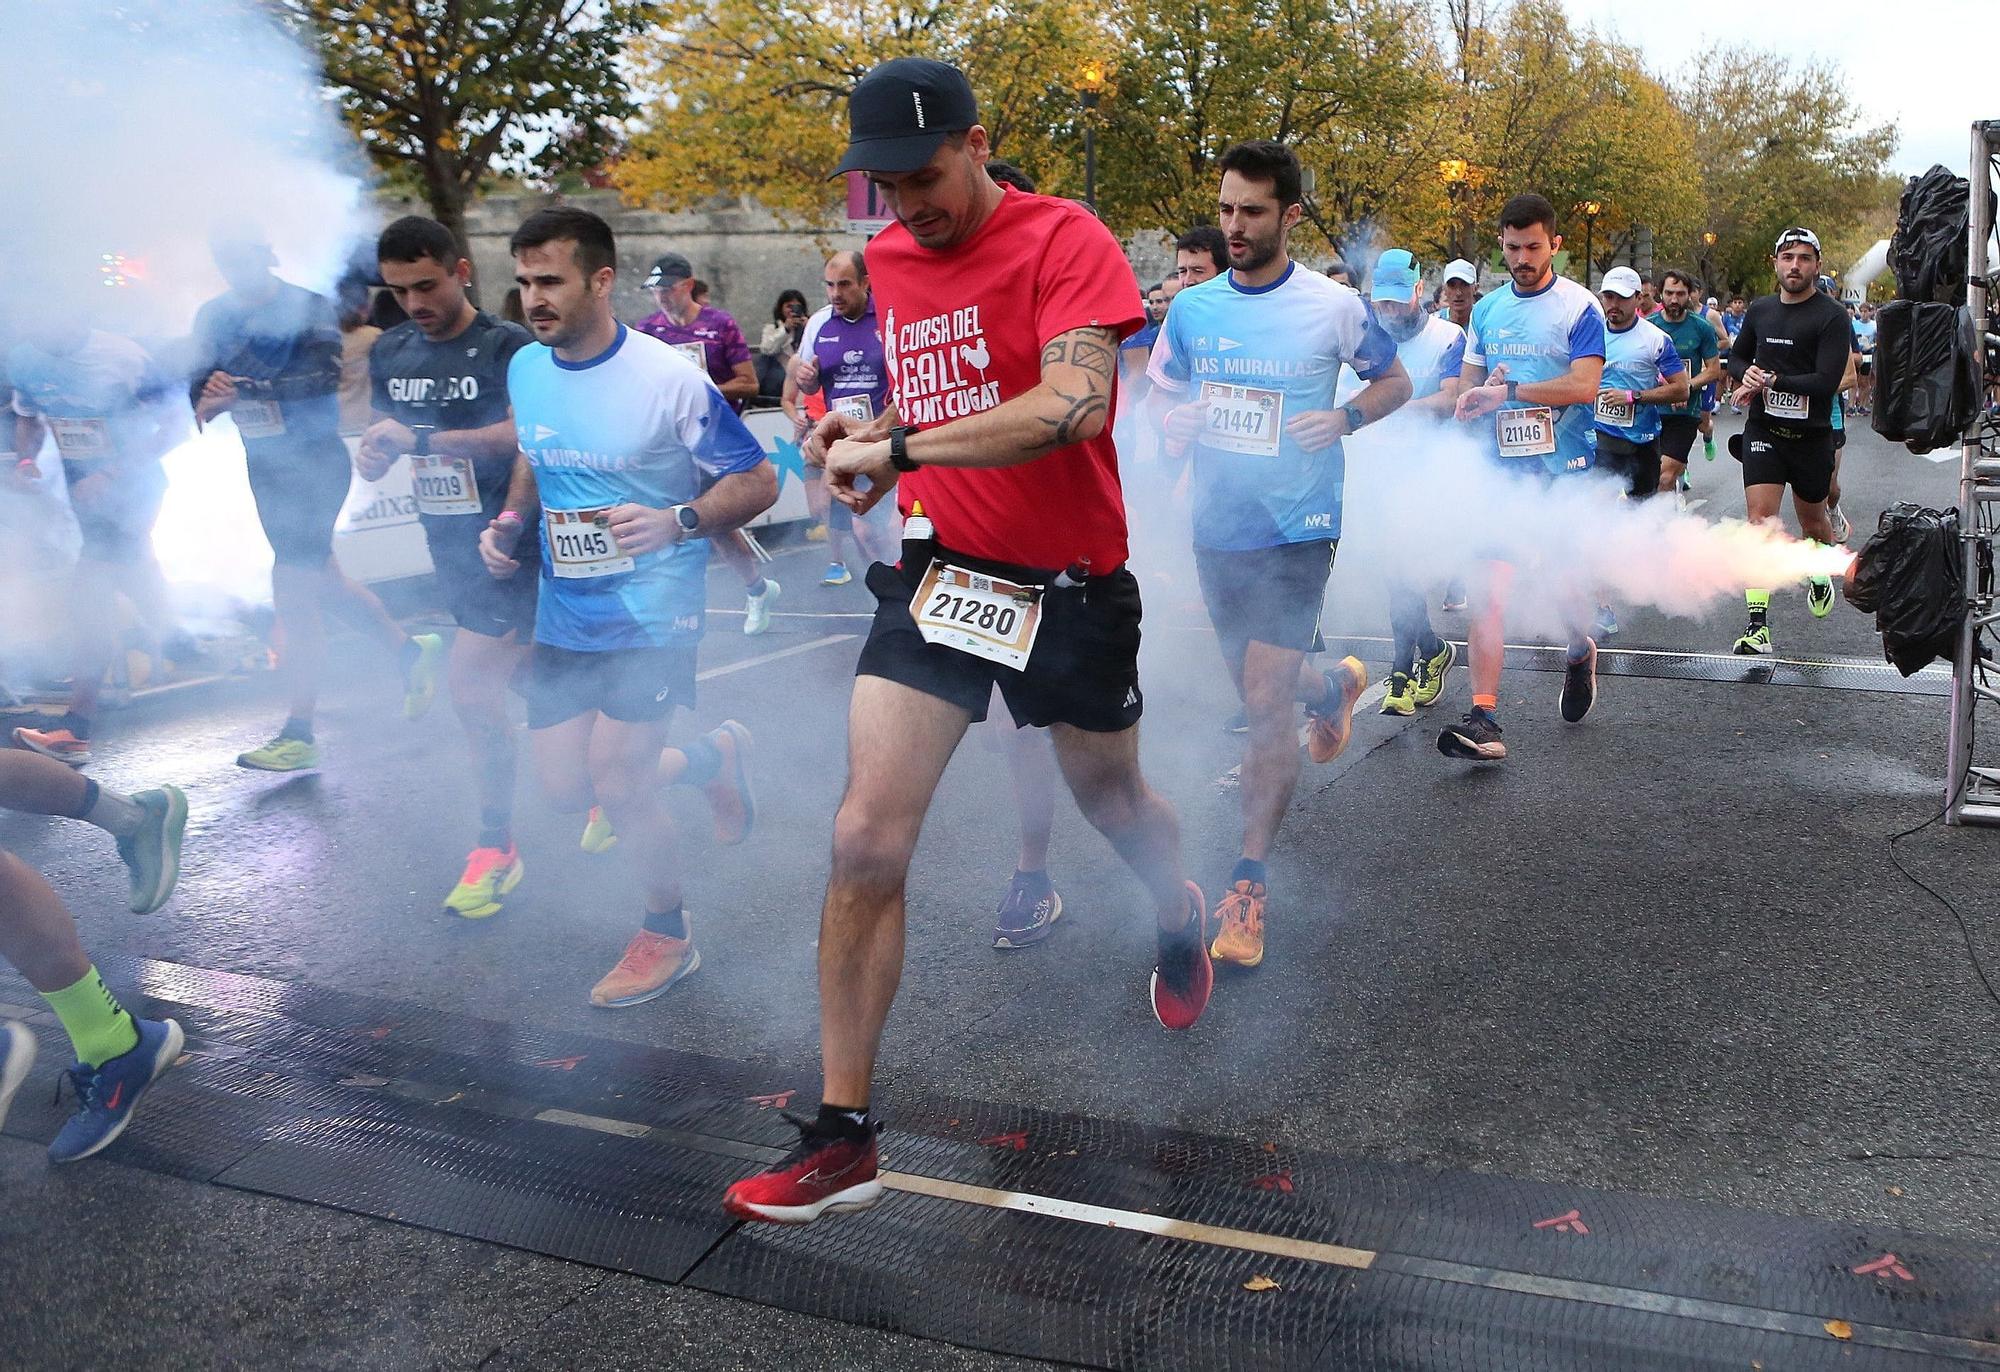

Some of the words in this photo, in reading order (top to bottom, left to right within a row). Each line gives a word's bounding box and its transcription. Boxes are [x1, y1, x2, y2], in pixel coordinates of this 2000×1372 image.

[900, 313, 951, 354] CURSA
[953, 305, 983, 340] DEL
[901, 346, 969, 399] GALL
[1194, 357, 1219, 374] LAS
[946, 381, 1001, 418] CUGAT
[1600, 402, 1626, 417] 21259
[1769, 393, 1800, 407] 21262
[1212, 407, 1264, 434] 21447
[1505, 425, 1541, 442] 21146
[419, 475, 462, 496] 21219
[556, 532, 608, 557] 21145
[929, 593, 1016, 636] 21280
